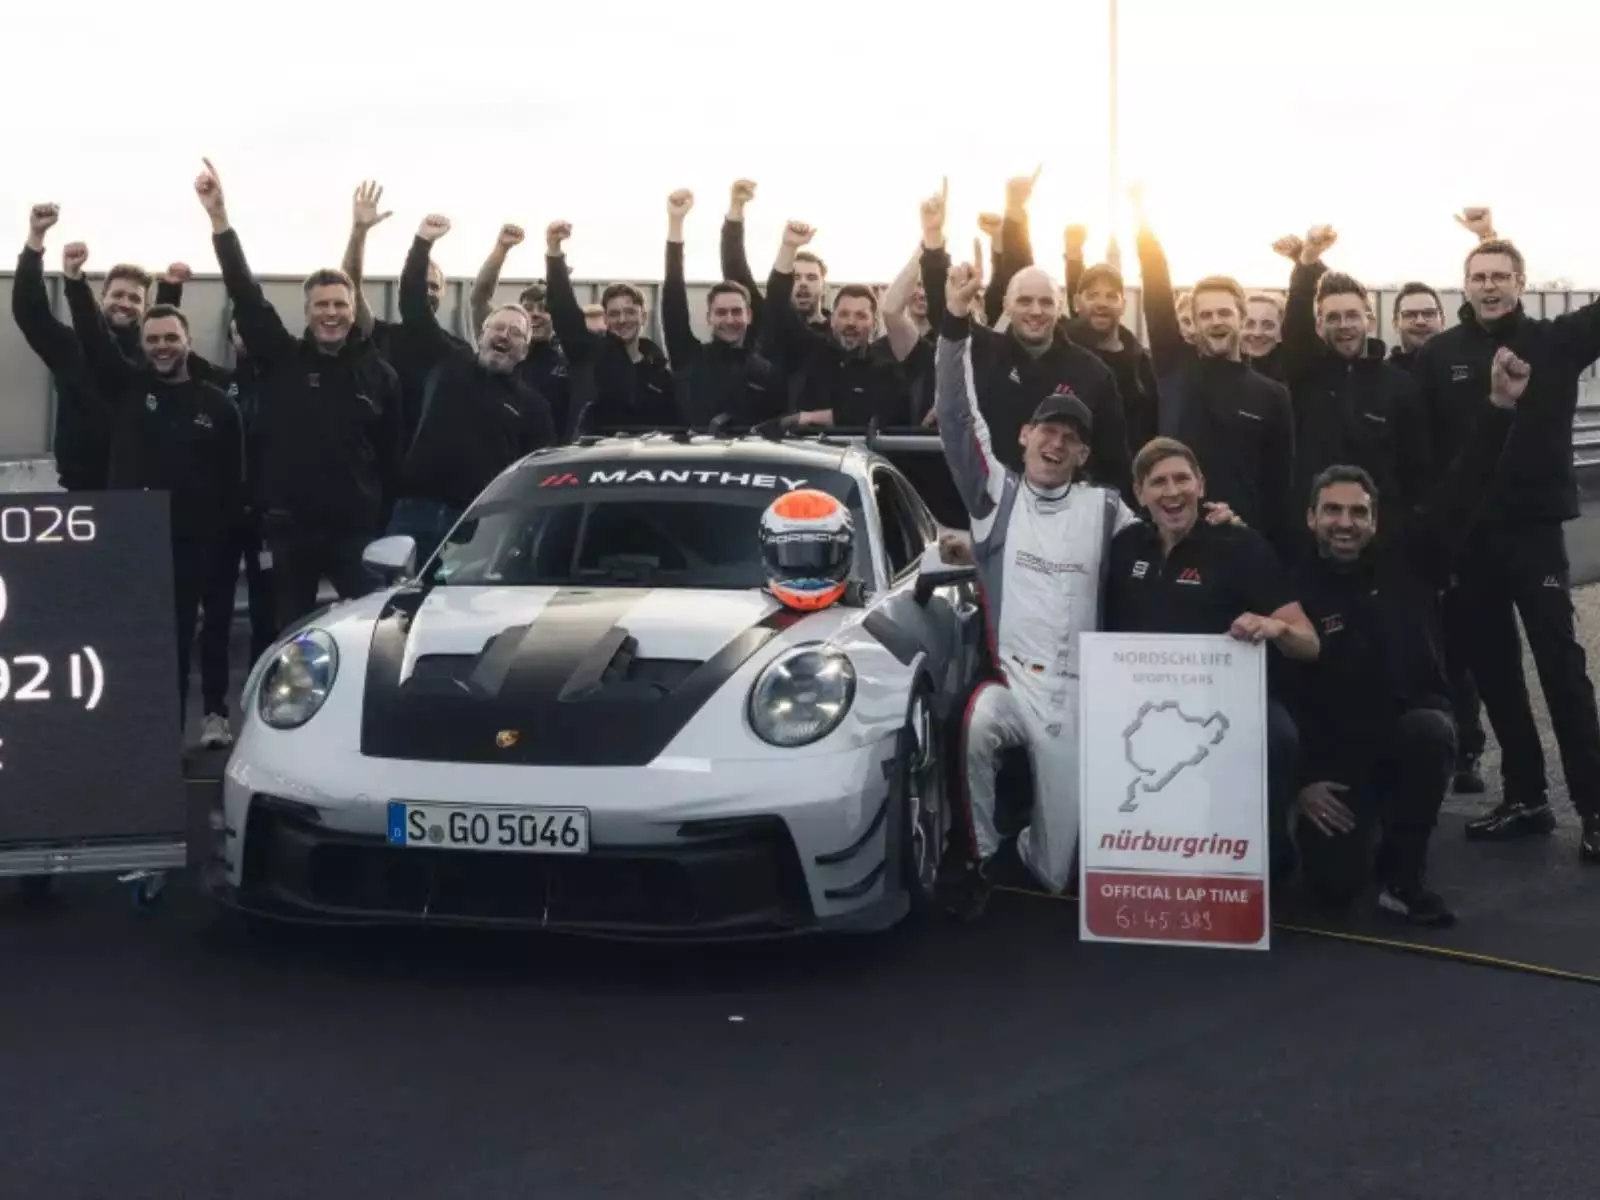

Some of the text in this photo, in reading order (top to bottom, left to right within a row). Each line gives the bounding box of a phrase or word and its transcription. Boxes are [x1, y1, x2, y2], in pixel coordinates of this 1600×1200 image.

[588, 469, 808, 490] MANTHEY
[1113, 651, 1233, 667] NORDSCHLEIFE
[1132, 672, 1214, 685] SPORTS CARS
[408, 810, 580, 847] S GO 5046
[1099, 829, 1249, 861] nürburgring
[1100, 883, 1249, 903] OFFICIAL LAP TIME
